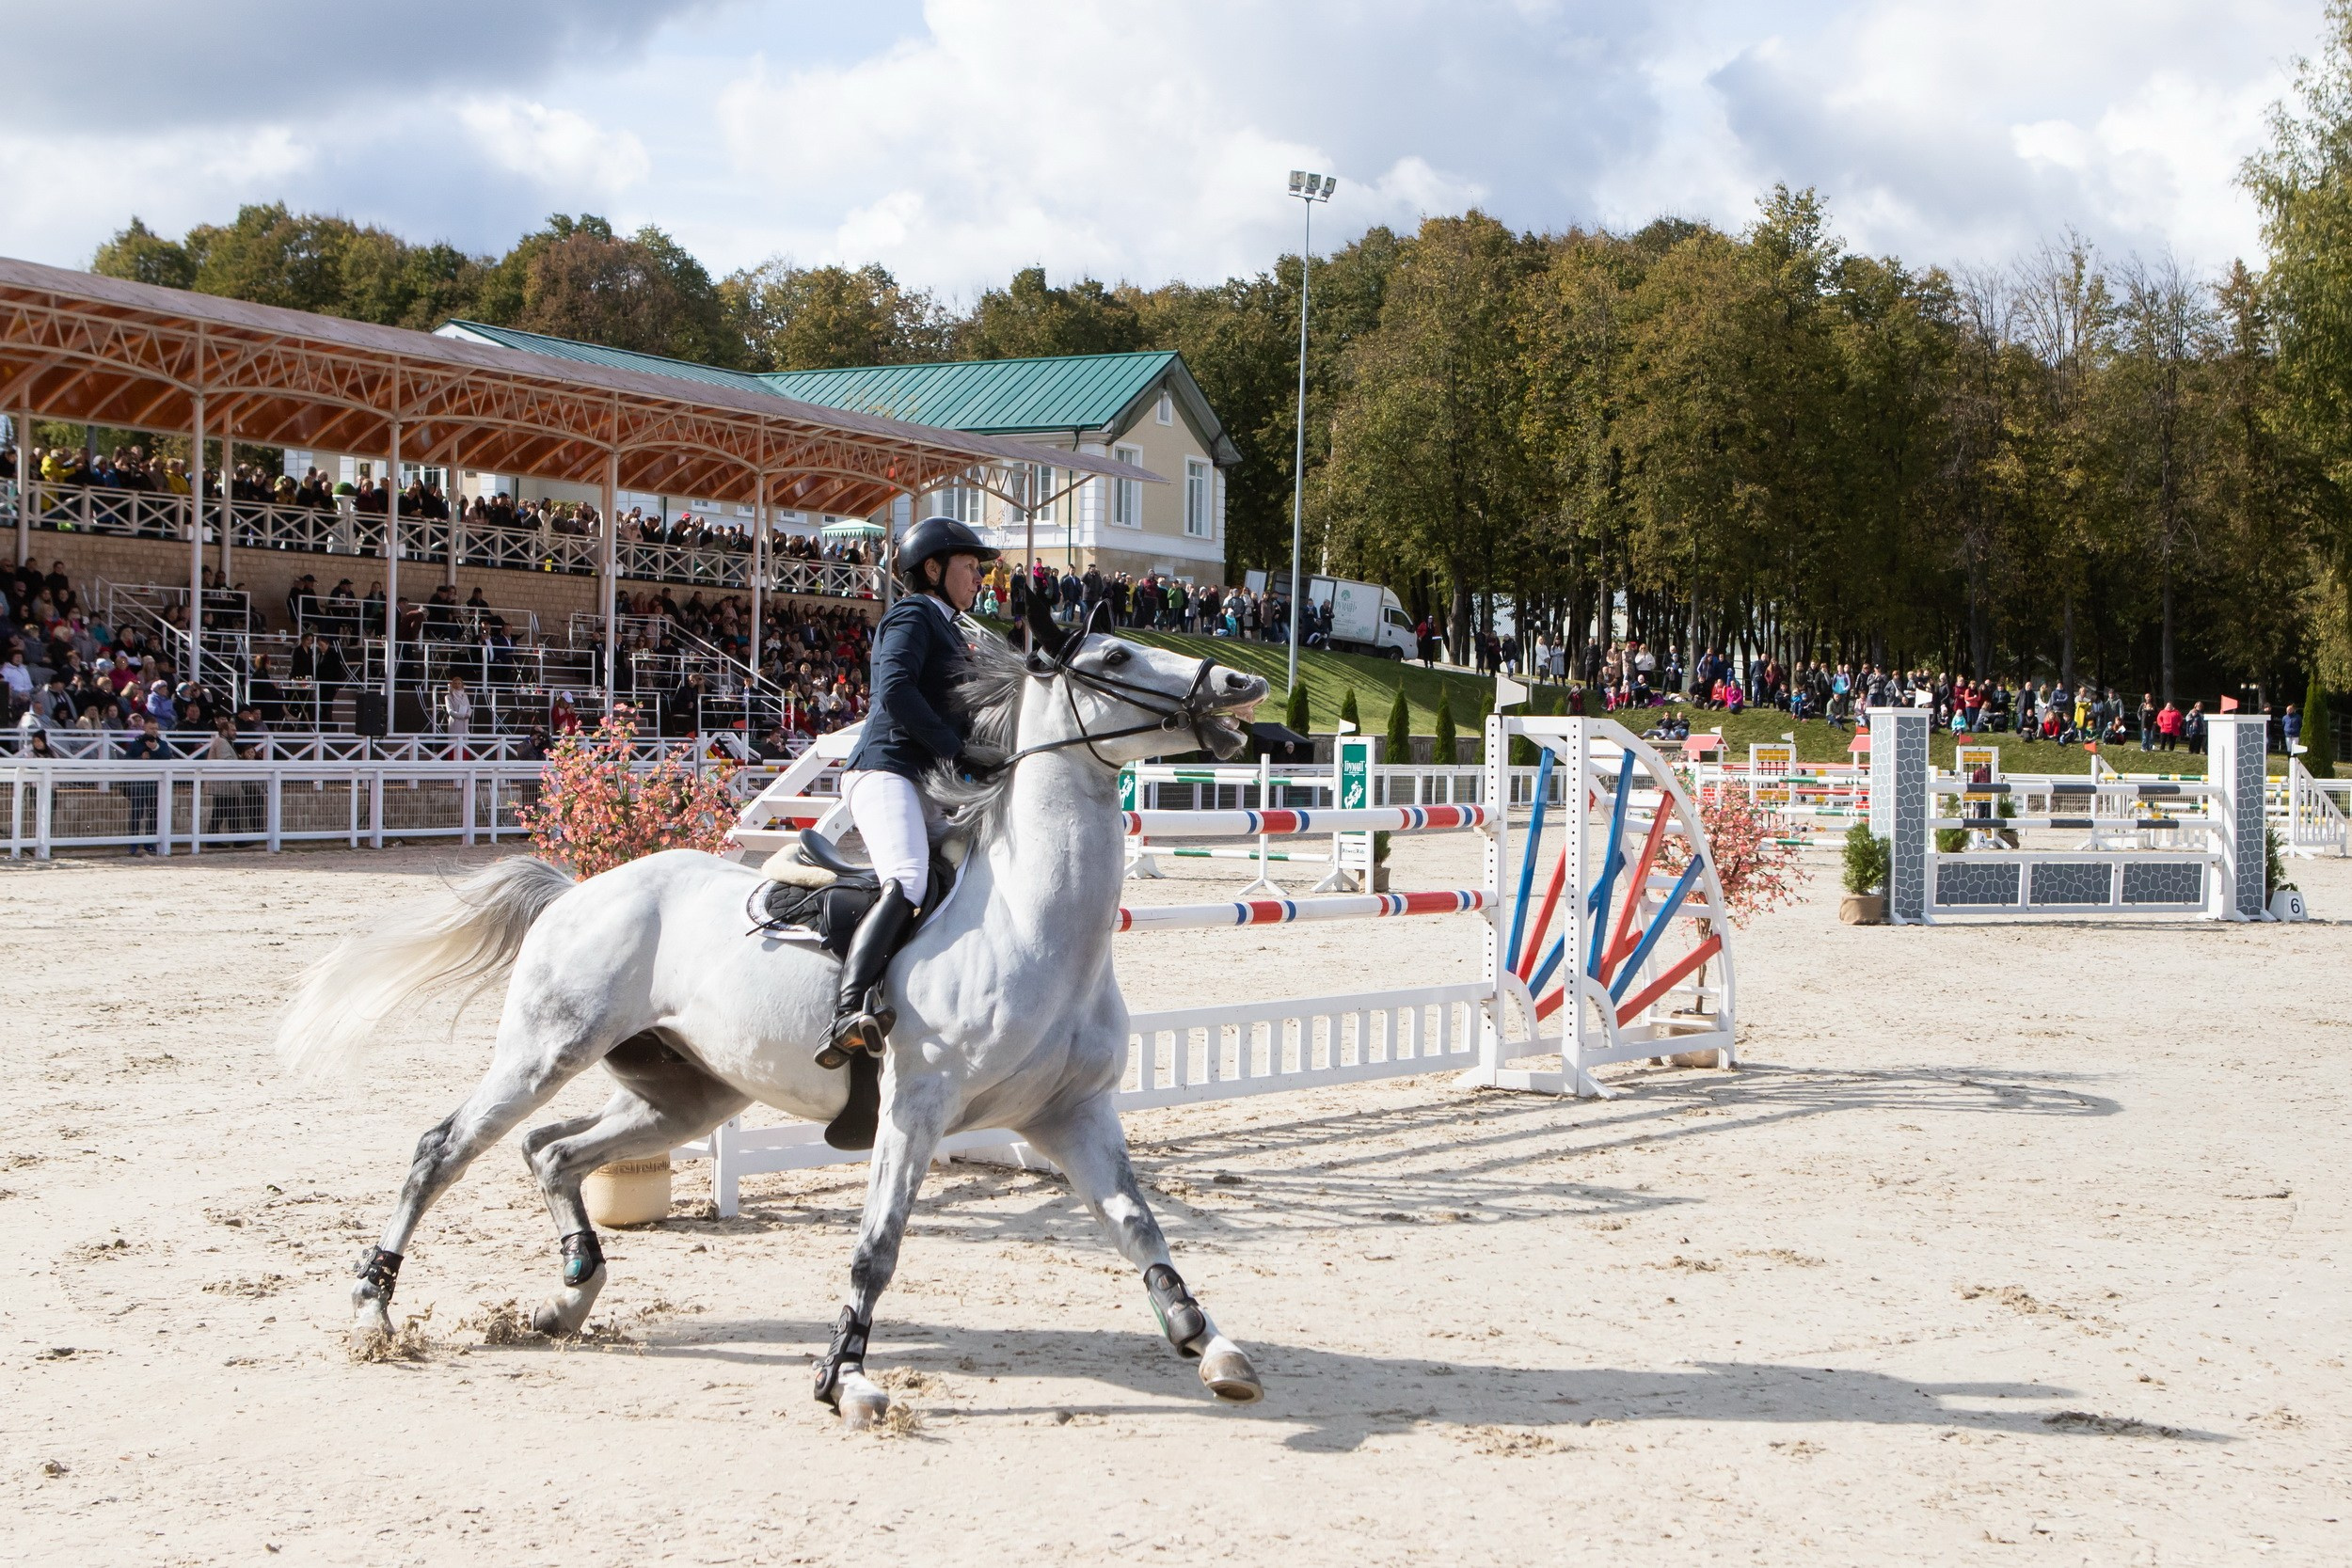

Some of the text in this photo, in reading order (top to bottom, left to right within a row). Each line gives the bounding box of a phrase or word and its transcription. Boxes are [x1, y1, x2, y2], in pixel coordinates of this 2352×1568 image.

[1344, 760, 1365, 771] ГРУМАНТ
[1980, 835, 1985, 845] 4
[2291, 898, 2300, 913] 6
